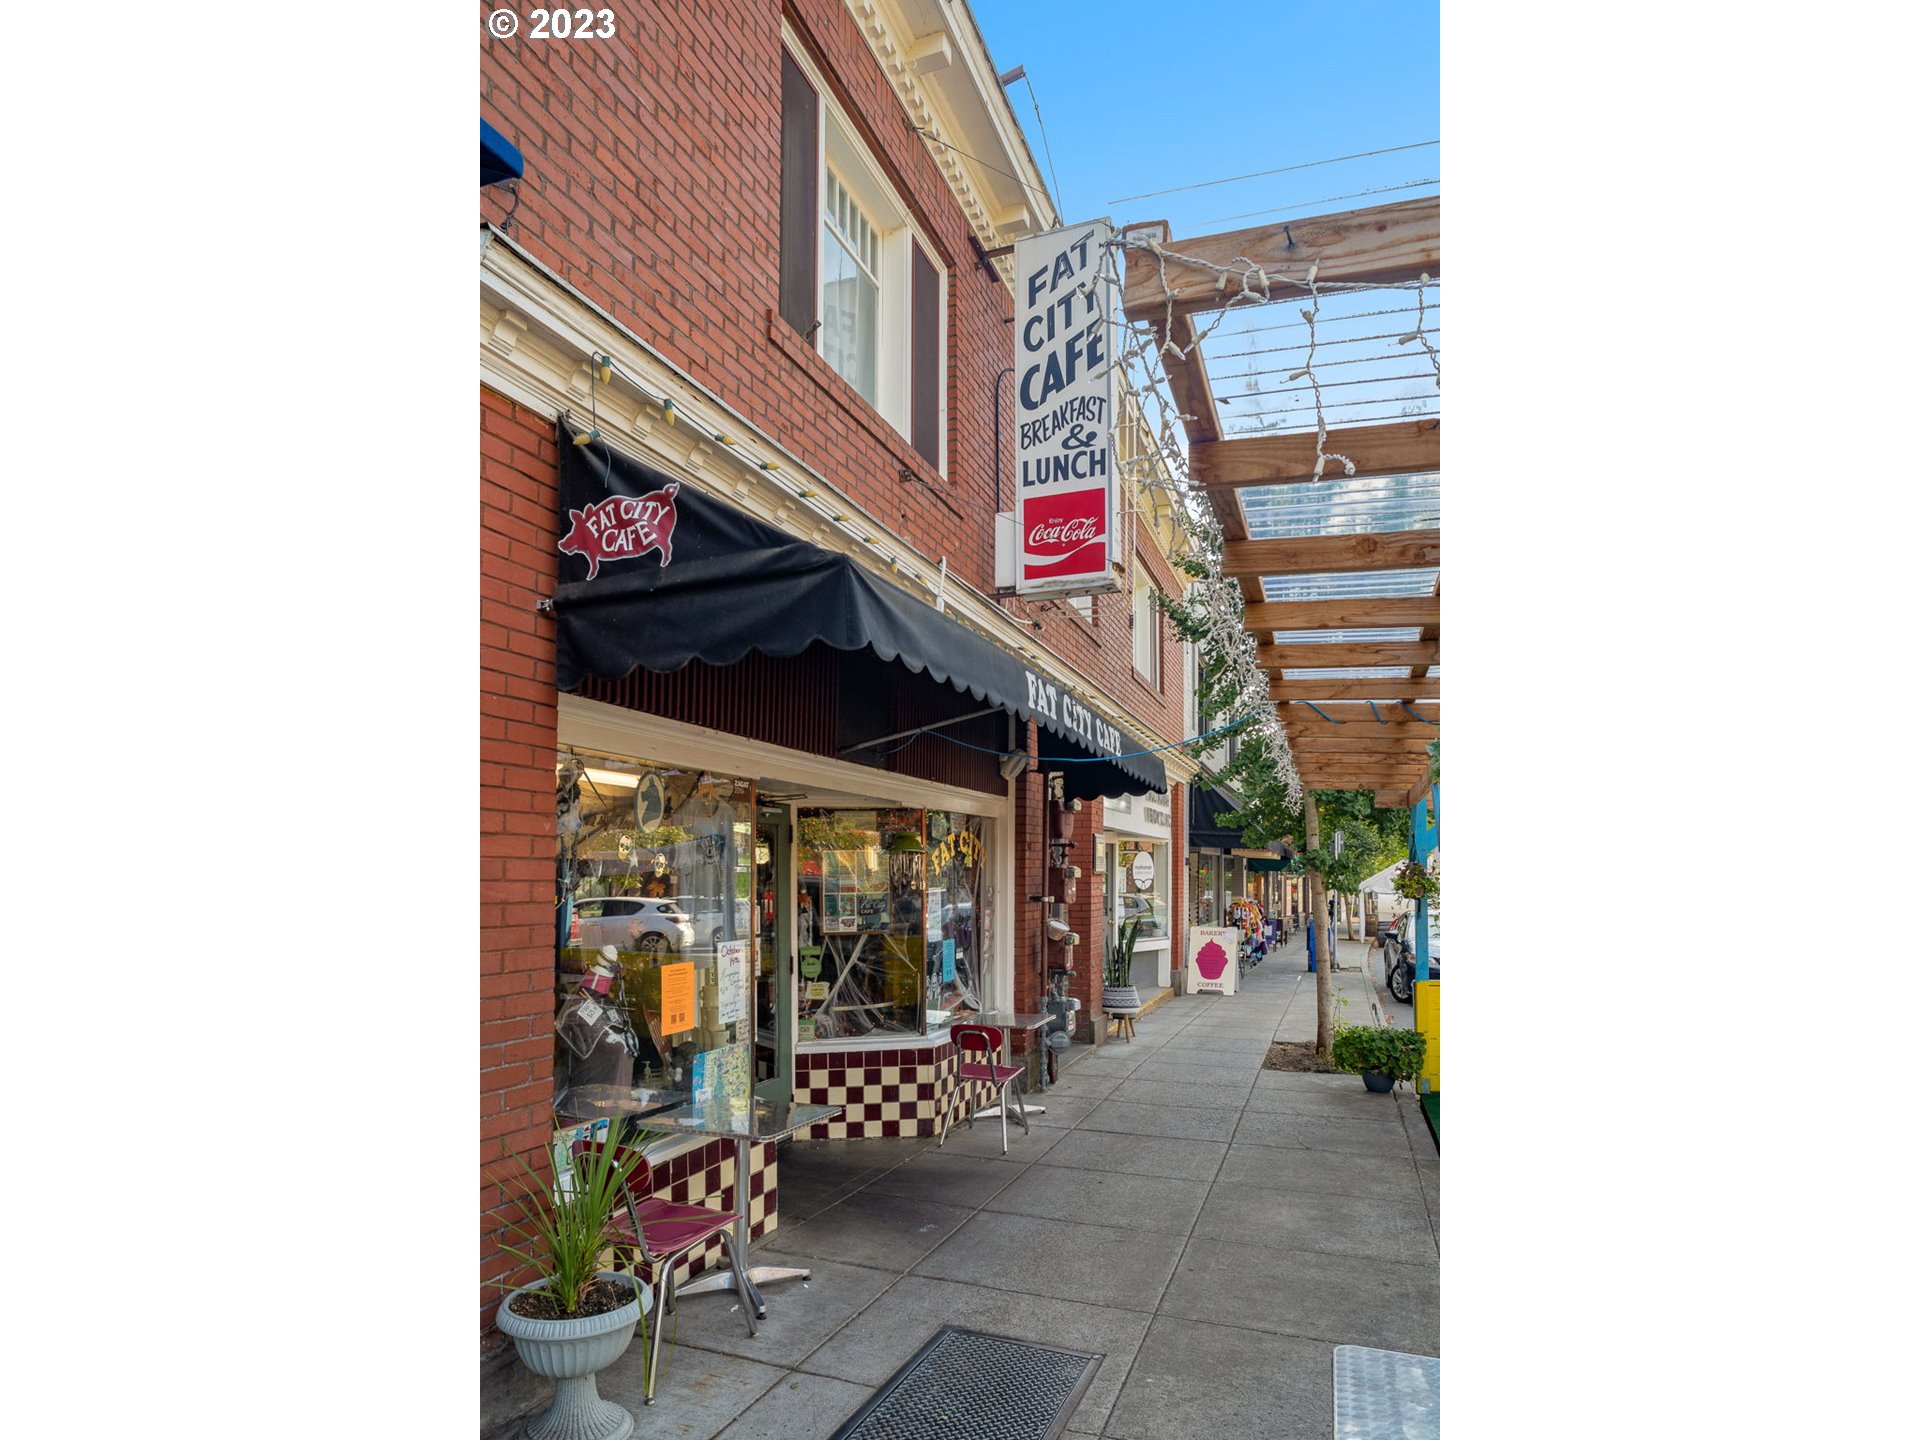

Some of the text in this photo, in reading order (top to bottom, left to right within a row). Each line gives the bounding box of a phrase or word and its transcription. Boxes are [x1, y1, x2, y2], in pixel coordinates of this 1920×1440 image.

[1028, 229, 1095, 310] FAT
[1023, 281, 1096, 352] CITY
[1020, 318, 1105, 411] CAFE
[1020, 395, 1107, 451] BREAKFAST
[1061, 423, 1098, 451] &
[1022, 447, 1106, 488] LUNCH
[585, 500, 671, 539] FAT CITY
[601, 520, 658, 552] CAFE
[1028, 516, 1100, 547] Coca-Cola
[1048, 517, 1064, 525] Enjoy
[1025, 670, 1058, 720] FAT
[1096, 718, 1122, 757] CAFE
[931, 830, 986, 877] FAT CITY
[1197, 981, 1225, 989] COFFEE
